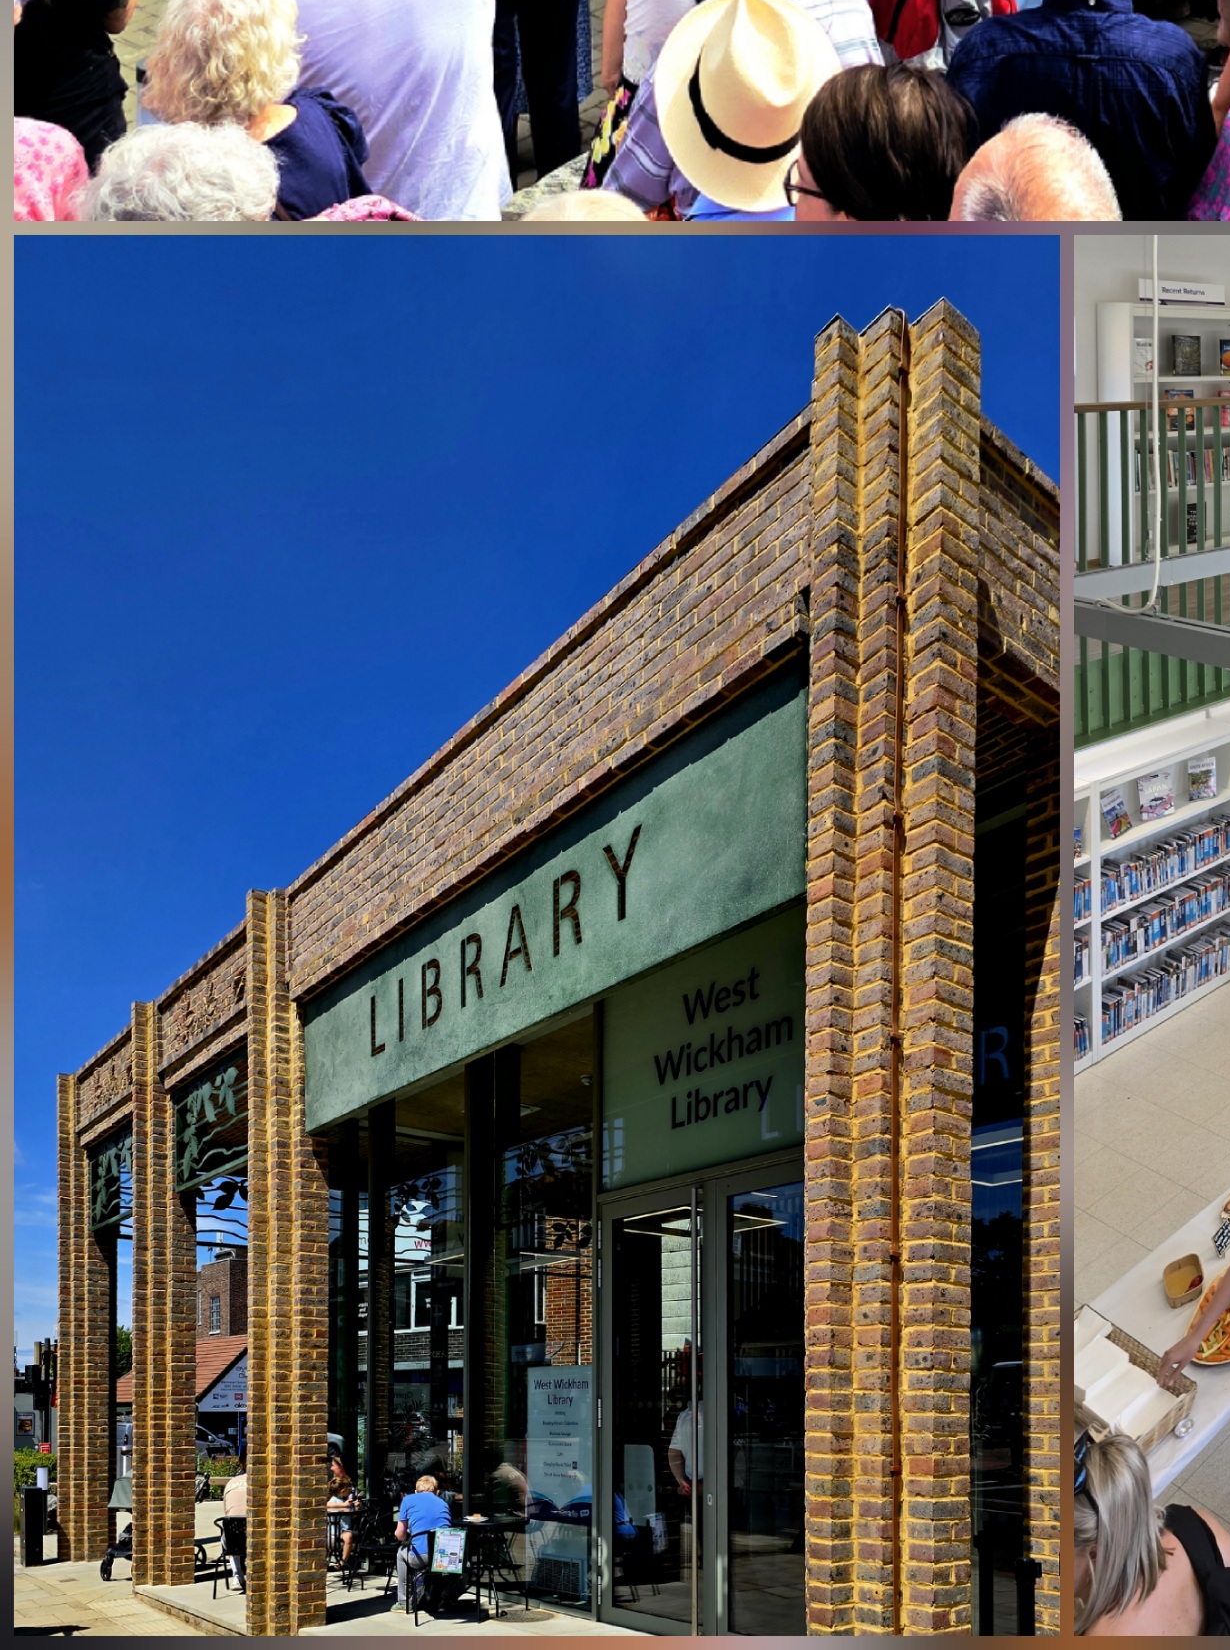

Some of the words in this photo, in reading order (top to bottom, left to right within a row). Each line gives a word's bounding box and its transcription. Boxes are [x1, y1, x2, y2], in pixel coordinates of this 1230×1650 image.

[1161, 286, 1183, 295] Recent
[1183, 288, 1206, 296] Returns
[370, 823, 643, 1057] LIBRARY
[682, 966, 760, 1026] West
[653, 1015, 794, 1086] Wickham
[671, 1075, 774, 1130] Library
[533, 1379, 551, 1391] West
[553, 1378, 589, 1391] Wickham
[547, 1394, 574, 1407] Library
